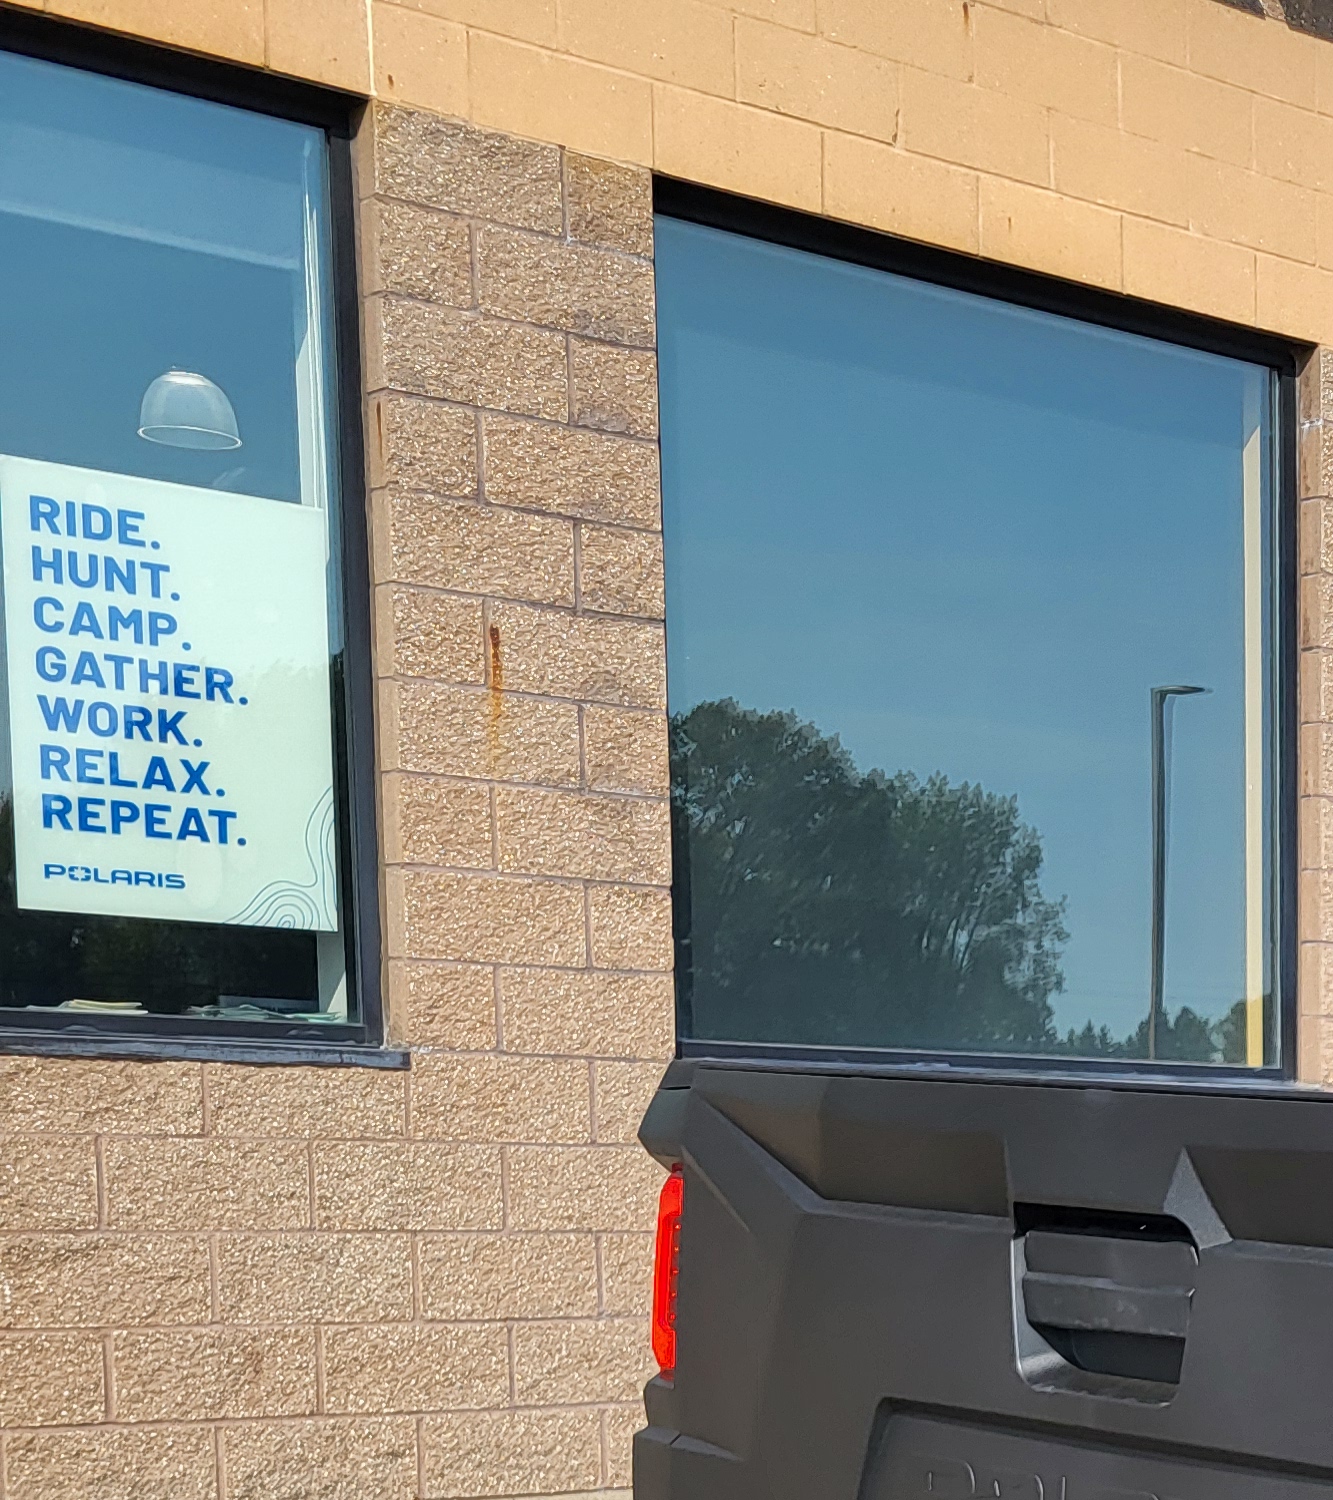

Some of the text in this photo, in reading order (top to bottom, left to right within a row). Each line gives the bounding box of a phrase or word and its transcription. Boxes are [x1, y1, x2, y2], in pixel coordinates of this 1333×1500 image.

[29, 494, 161, 550] RIDE.
[32, 545, 181, 601] HUNT.
[33, 596, 192, 651] CAMP.
[35, 646, 249, 706] GATHER.
[36, 694, 203, 747] WORK.
[40, 743, 226, 797] RELAX.
[41, 793, 247, 847] REPEAT.
[43, 863, 186, 890] POLARIS
